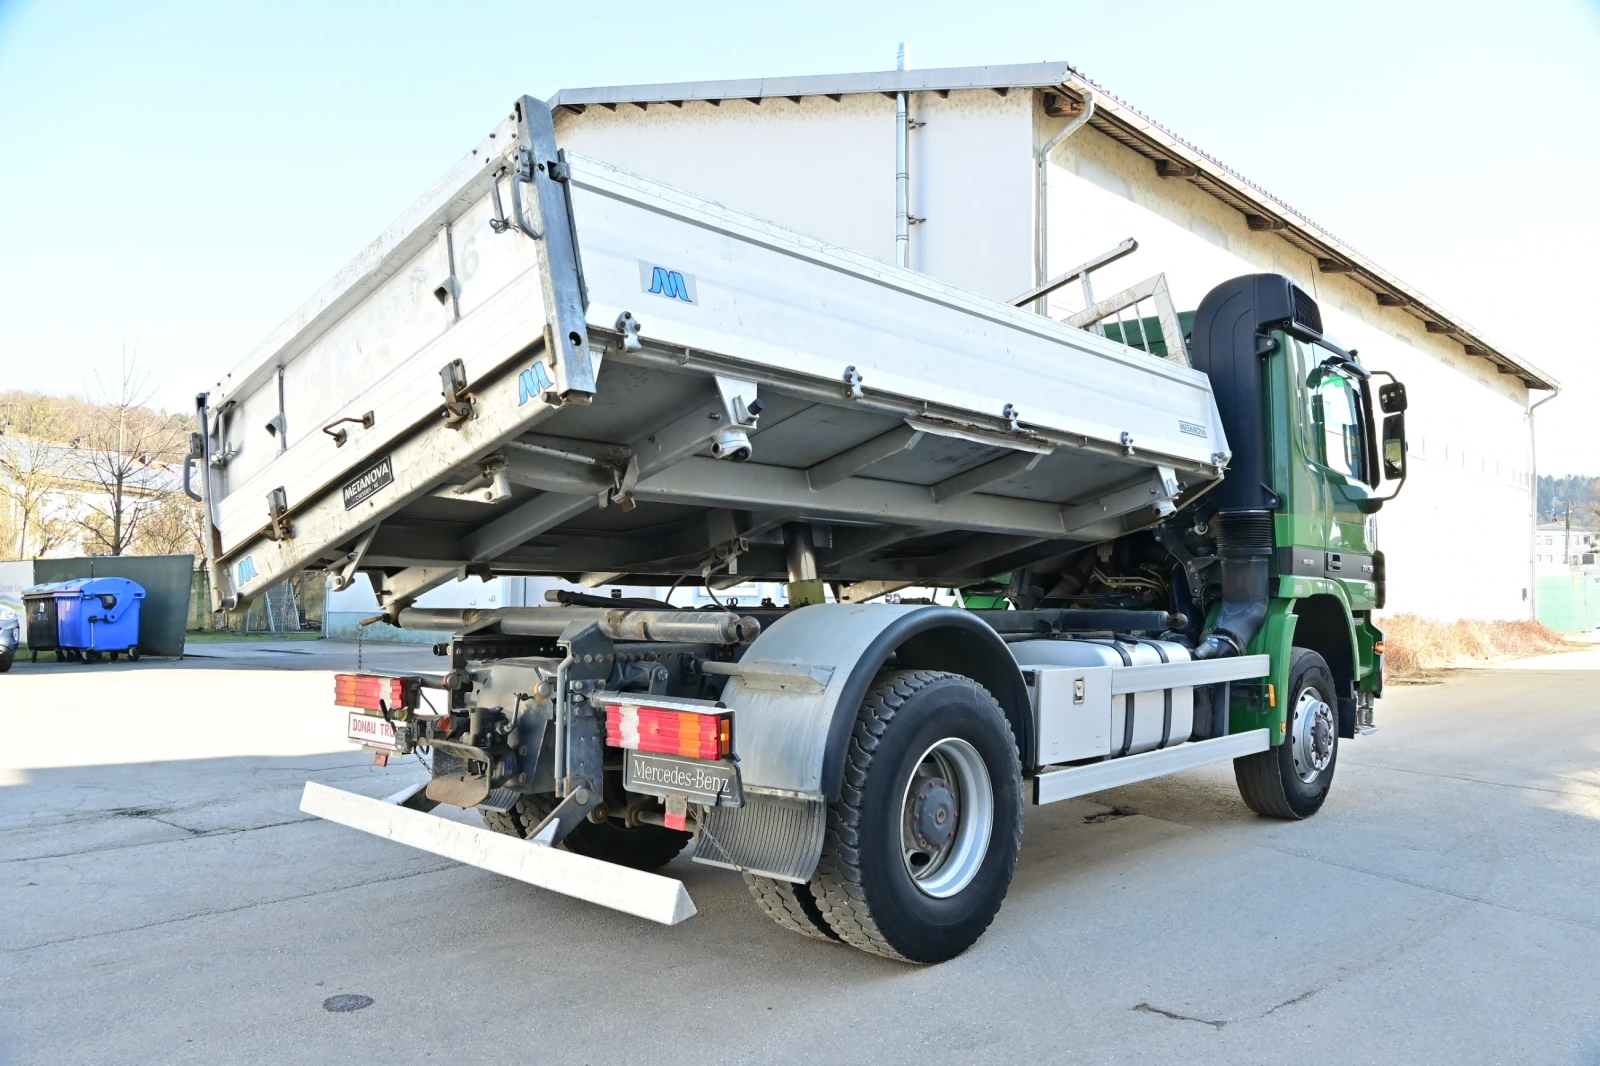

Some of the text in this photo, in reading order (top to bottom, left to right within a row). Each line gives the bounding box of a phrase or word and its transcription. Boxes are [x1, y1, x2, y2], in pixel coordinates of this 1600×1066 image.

[344, 462, 389, 501] METANOVA
[352, 718, 401, 738] DONAU TRU
[633, 759, 730, 793] Mercedes-Benz
